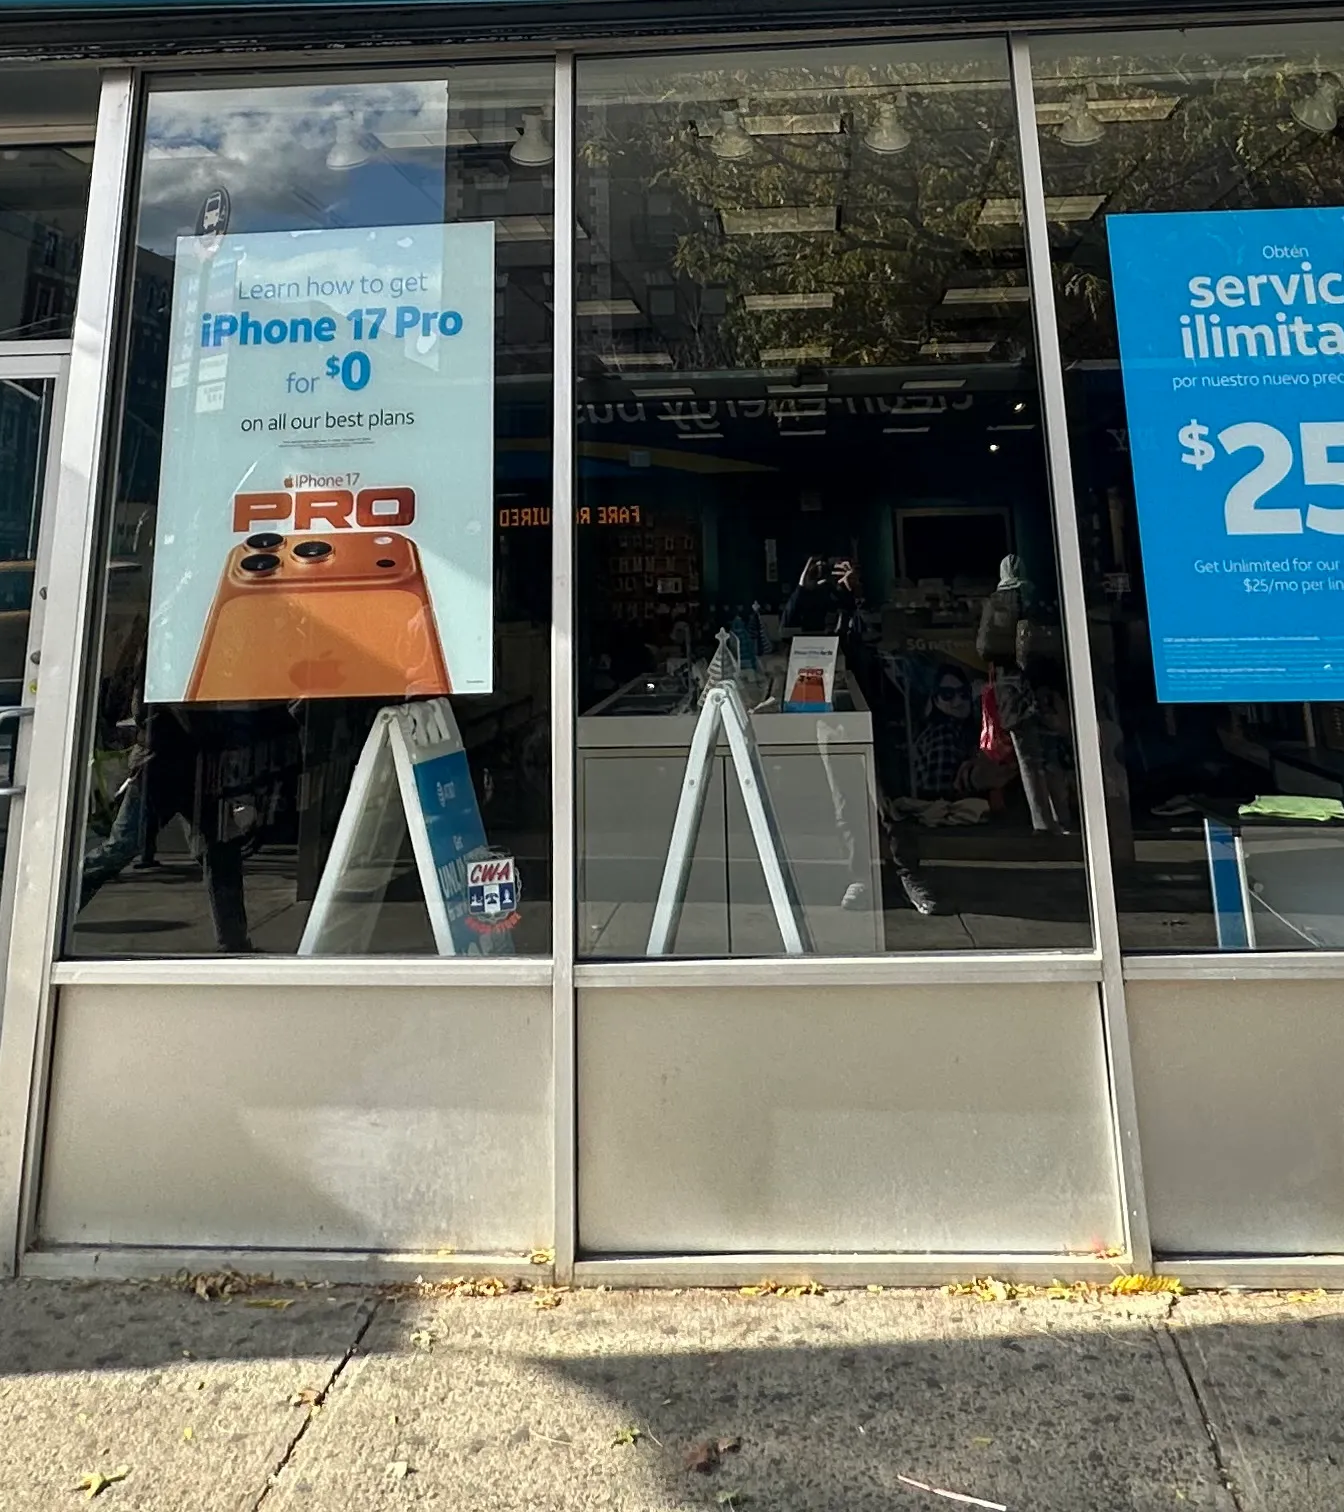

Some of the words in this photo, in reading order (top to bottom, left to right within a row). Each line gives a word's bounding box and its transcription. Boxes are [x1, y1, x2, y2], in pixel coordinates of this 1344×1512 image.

[1262, 244, 1309, 259] Obtén
[238, 280, 301, 301] Learn
[307, 276, 355, 297] how
[360, 276, 384, 294] to
[390, 272, 428, 299] get
[201, 311, 336, 347] iPhone
[346, 307, 387, 340] 17
[396, 305, 463, 338] Pro
[286, 371, 321, 394] for
[325, 350, 371, 391] $0
[1172, 375, 1198, 391] por
[1201, 373, 1259, 387] nuestro
[1263, 373, 1309, 386] nuevo
[241, 418, 263, 432] on
[268, 413, 286, 431] all
[291, 415, 321, 430] our
[325, 411, 364, 428] best
[368, 409, 414, 433] plans
[345, 473, 360, 486] 17
[232, 486, 416, 533] PRO
[1194, 559, 1219, 574] Get
[1222, 558, 1289, 573] Unlimited
[1293, 557, 1312, 571] for
[1316, 561, 1339, 571] our
[1243, 578, 1298, 594] $25/mo
[1302, 580, 1323, 594] per
[470, 861, 511, 884] CWA
